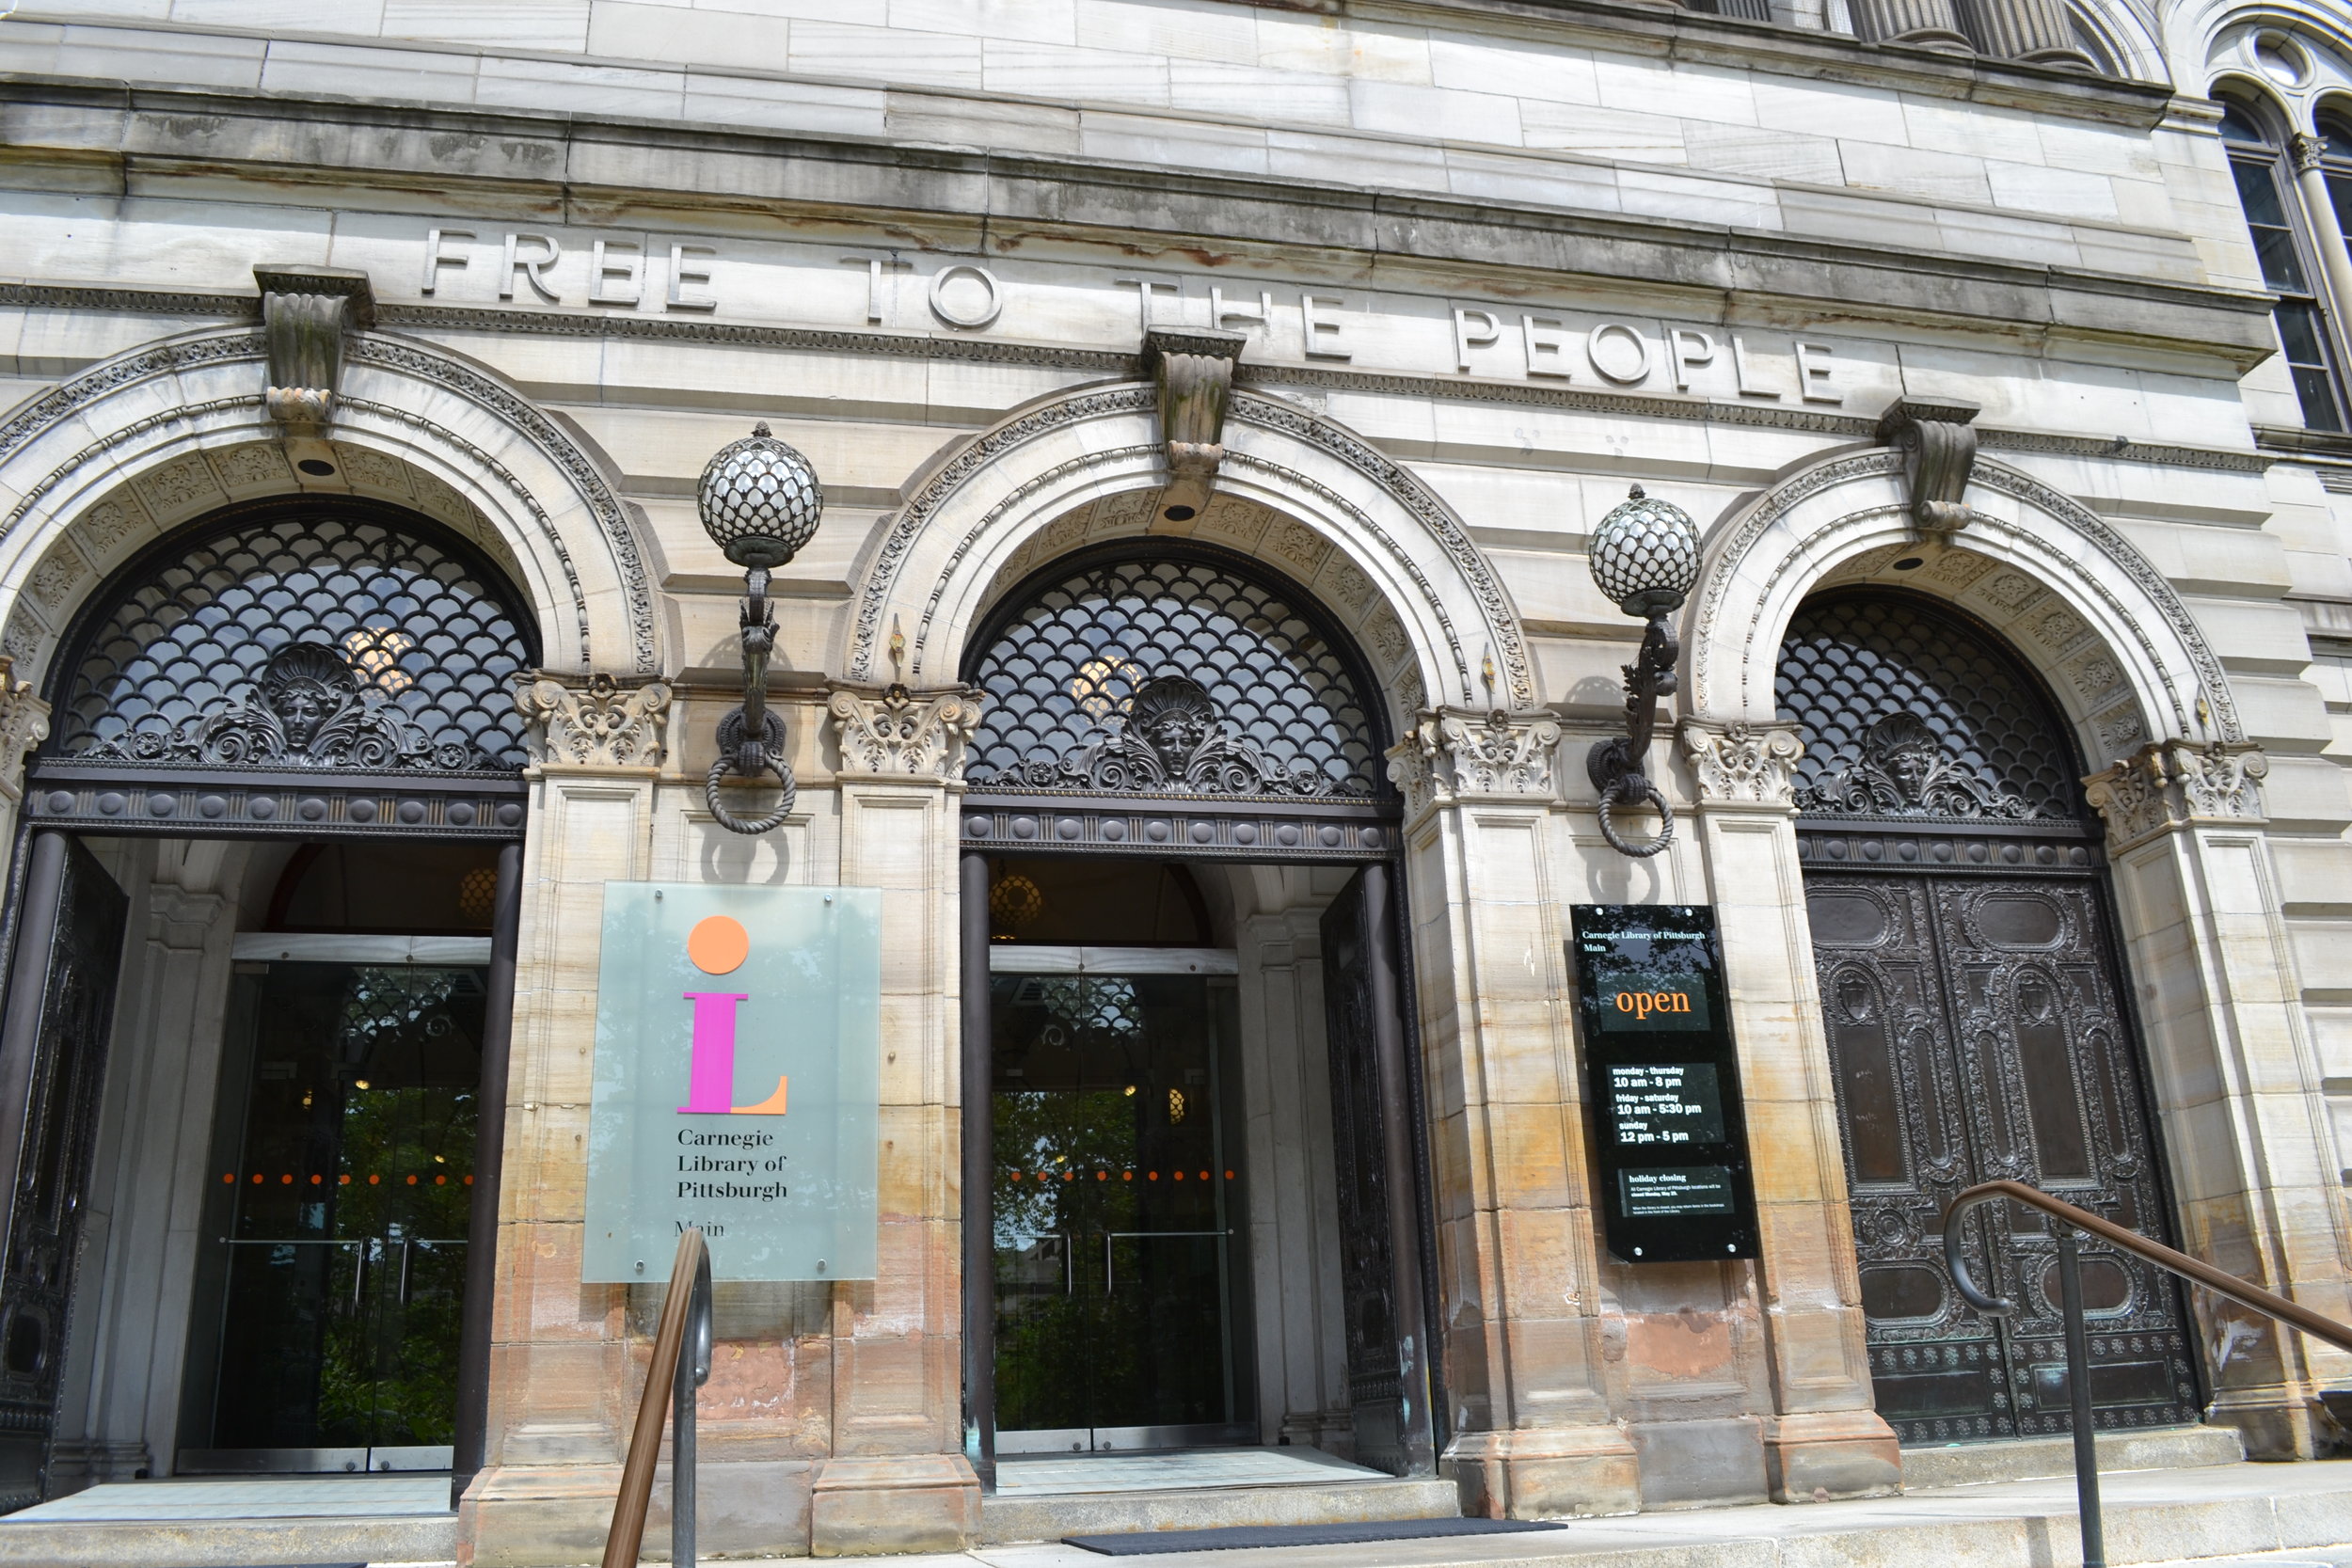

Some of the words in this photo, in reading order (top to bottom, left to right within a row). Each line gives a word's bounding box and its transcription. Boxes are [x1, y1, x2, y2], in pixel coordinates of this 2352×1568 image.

[421, 229, 717, 309] FREE
[840, 255, 1003, 328] TO
[1116, 277, 1353, 361] THE
[1453, 307, 1844, 404] PEOPLE
[1581, 930, 1619, 941] Carnegie
[1621, 931, 1651, 941] Library
[1653, 931, 1662, 940] of
[1663, 930, 1706, 941] Pittsburgh
[1583, 943, 1606, 952] Main
[1616, 992, 1692, 1020] open
[1613, 1067, 1644, 1076] monday
[1649, 1066, 1684, 1076] thursday
[1613, 1077, 1629, 1087] 10
[1630, 1078, 1647, 1087] am
[1655, 1076, 1663, 1086] 8
[1665, 1077, 1682, 1088] pm
[1615, 1094, 1639, 1103] friday
[1645, 1093, 1679, 1102] saturday
[1617, 1104, 1632, 1115] 10
[1634, 1105, 1651, 1115] am
[1659, 1103, 1683, 1114] 5:30
[1685, 1104, 1702, 1116] pm
[1619, 1121, 1647, 1131] sunday
[677, 1129, 773, 1151] Carnegie
[1620, 1132, 1636, 1142] 12
[1637, 1132, 1655, 1144] pm
[1662, 1131, 1670, 1141] 5
[1672, 1132, 1689, 1143] pm
[677, 1155, 758, 1177] Library
[765, 1155, 787, 1172] of
[1629, 1175, 1658, 1183] holiday
[1659, 1174, 1687, 1182] closing
[677, 1181, 787, 1203] Pittsburgh
